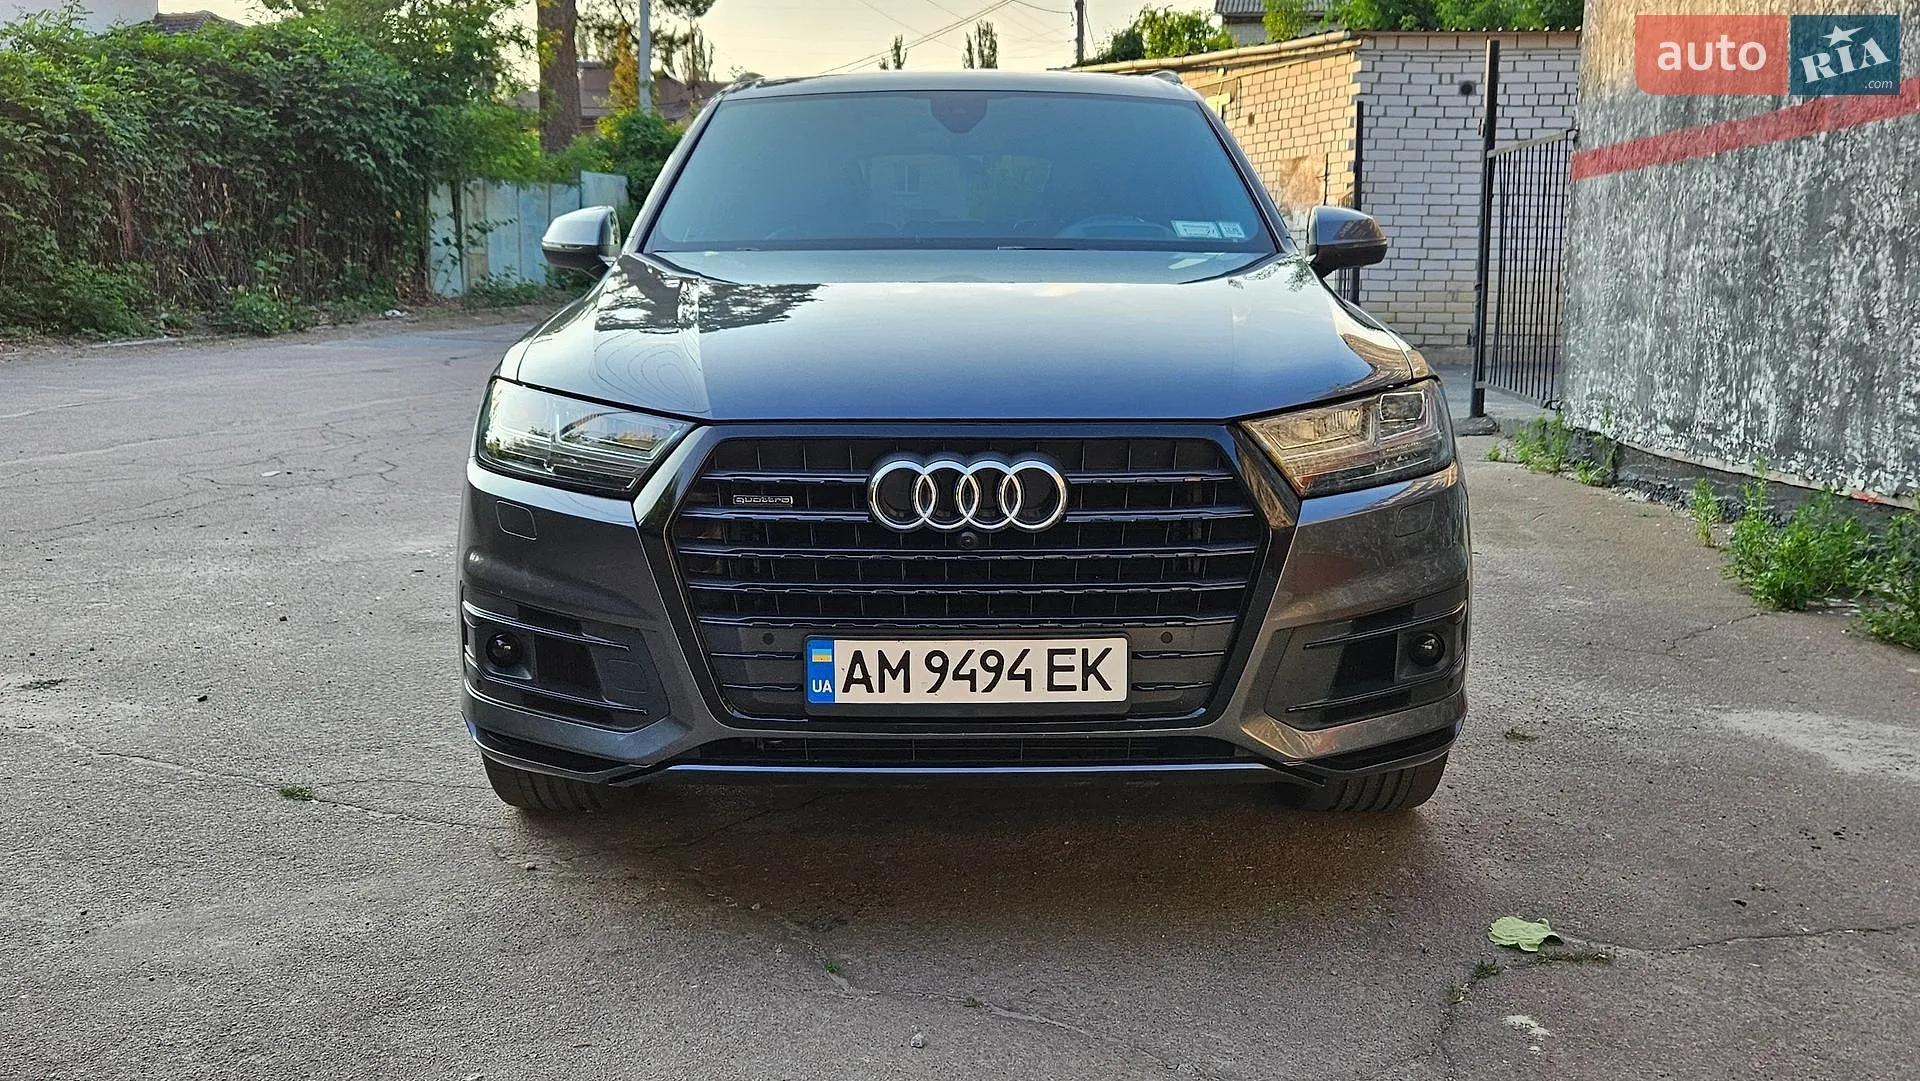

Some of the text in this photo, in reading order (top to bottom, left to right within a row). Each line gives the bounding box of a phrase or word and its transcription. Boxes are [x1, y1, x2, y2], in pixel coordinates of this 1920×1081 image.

[735, 496, 790, 504] quattro
[841, 647, 1113, 694] AM 9494 EK
[812, 679, 832, 693] UA
